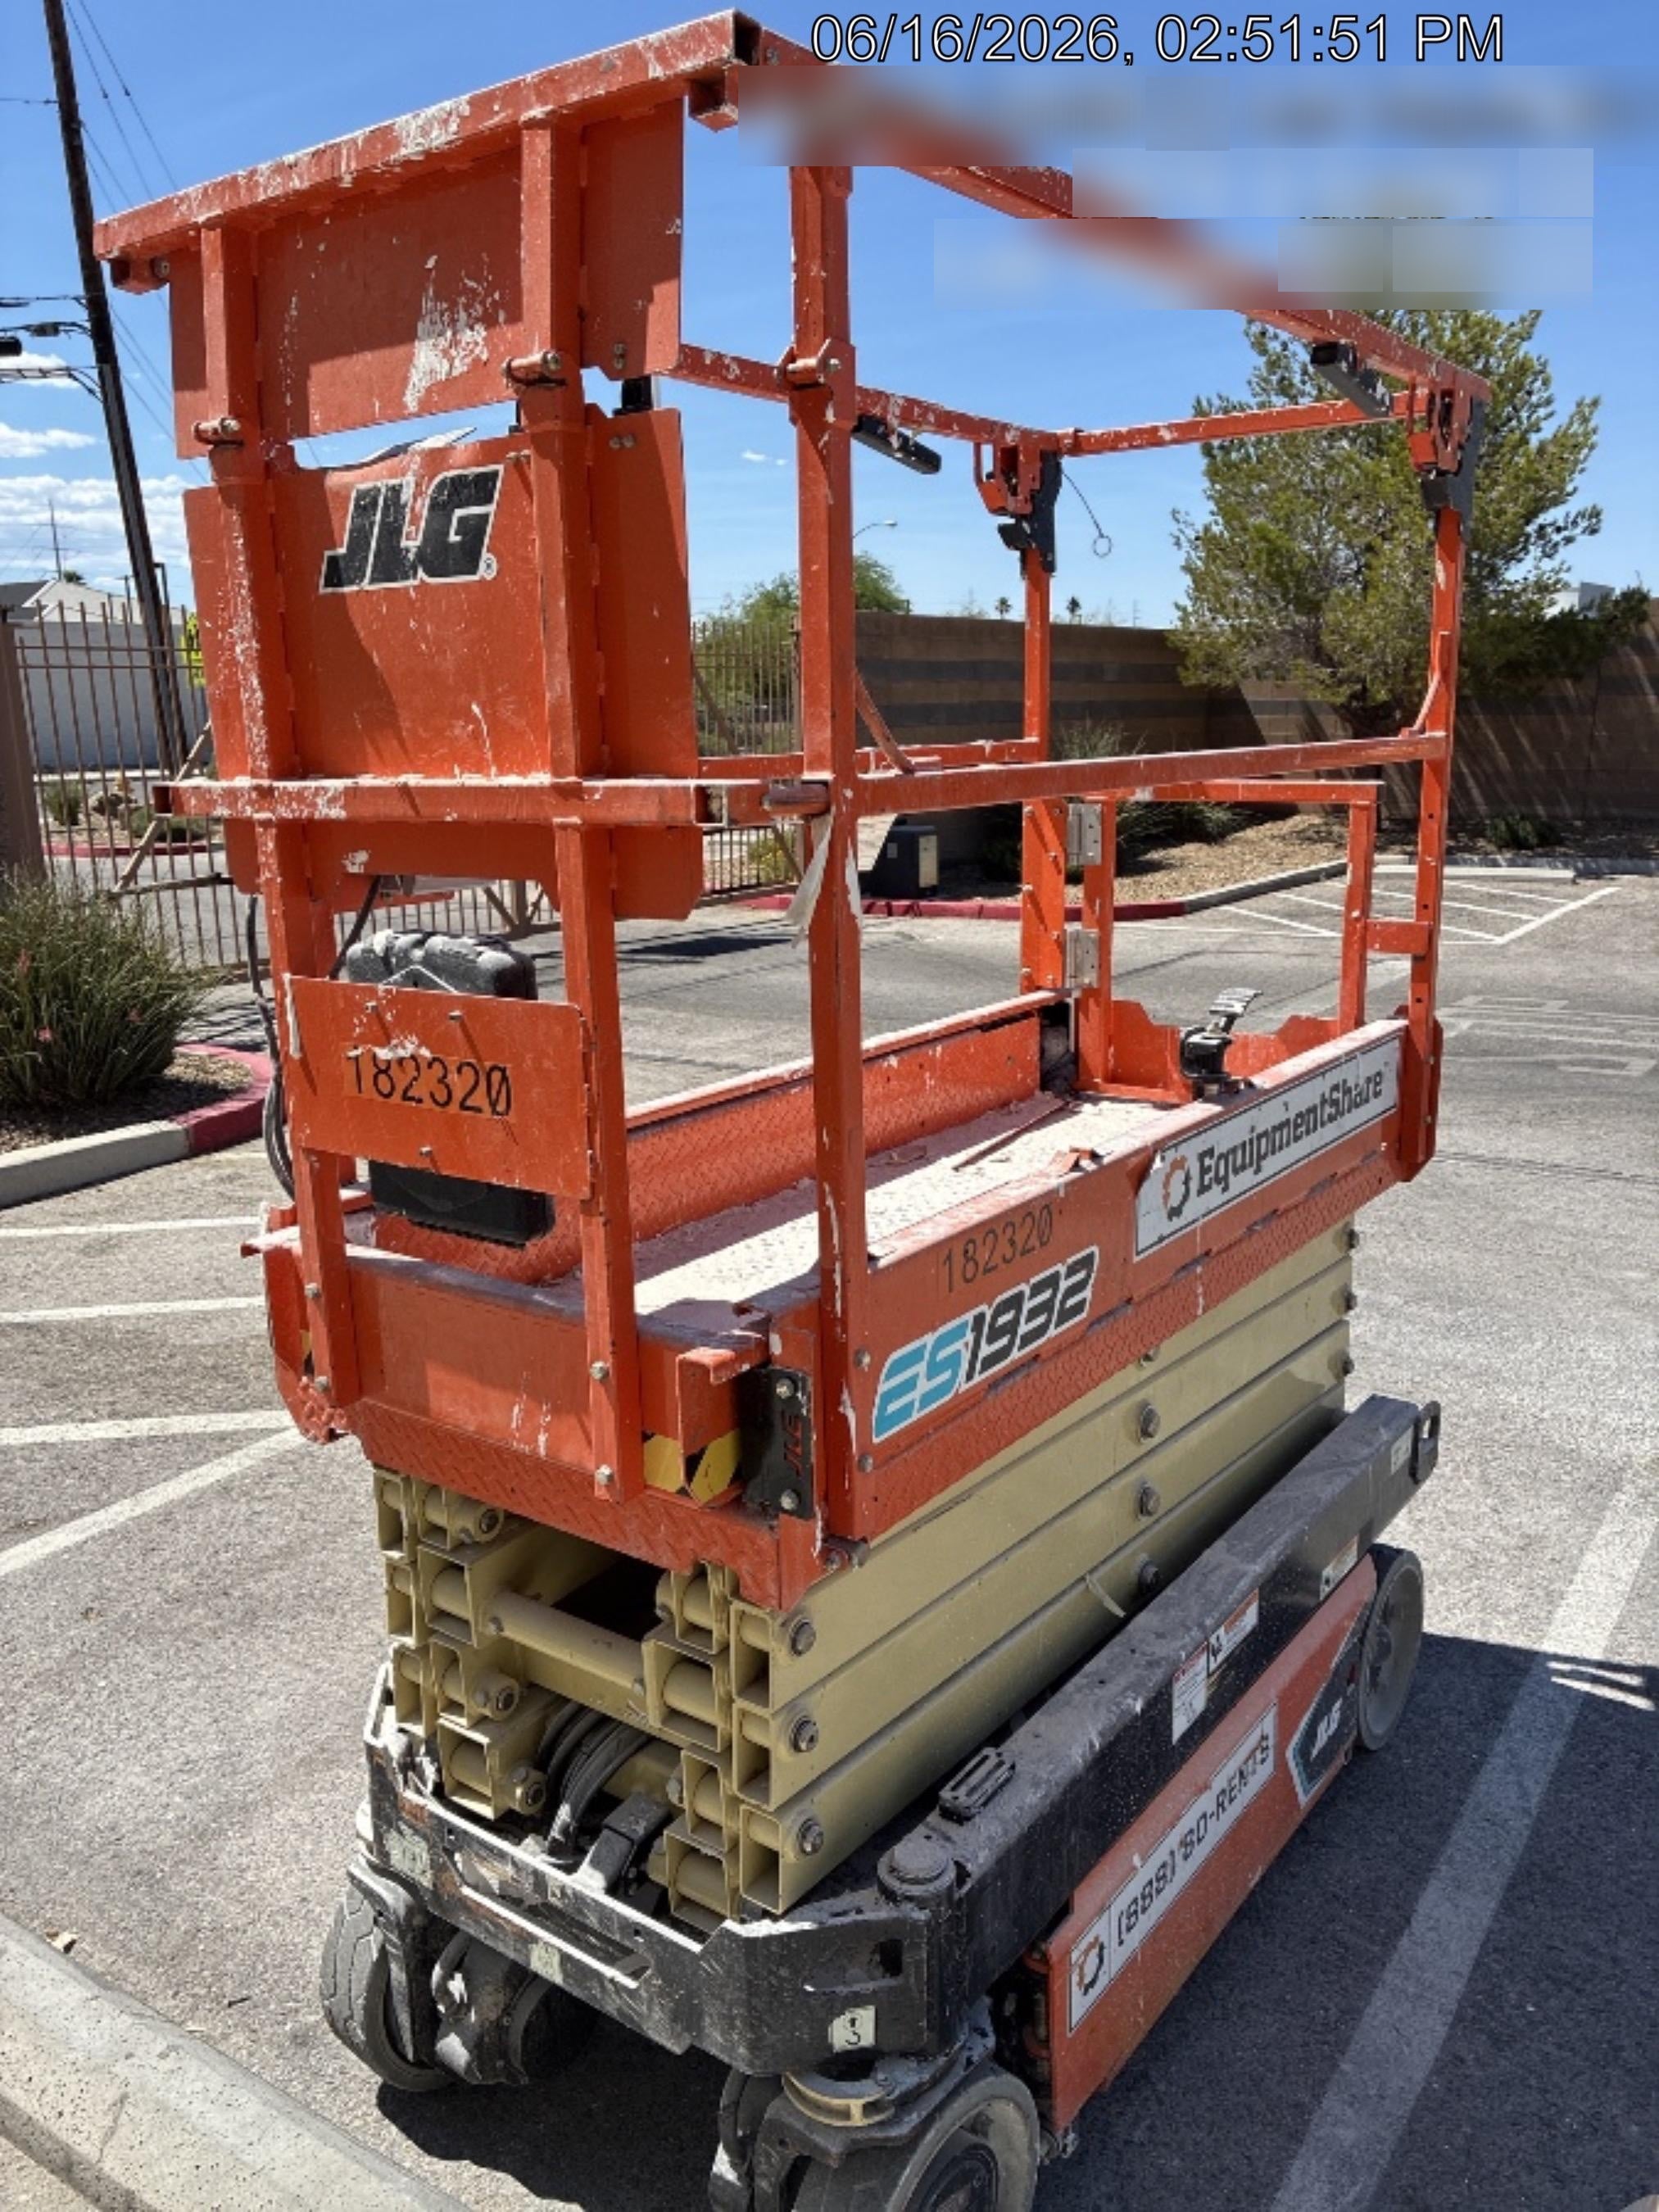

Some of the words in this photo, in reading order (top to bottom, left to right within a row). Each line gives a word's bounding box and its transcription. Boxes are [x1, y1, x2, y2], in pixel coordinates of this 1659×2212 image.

[320, 464, 505, 594] JLG
[346, 1045, 512, 1117] 182320
[1196, 1068, 1384, 1197] EquipmentShare
[943, 1203, 1054, 1294] 182320
[873, 1244, 1099, 1444] ES1932
